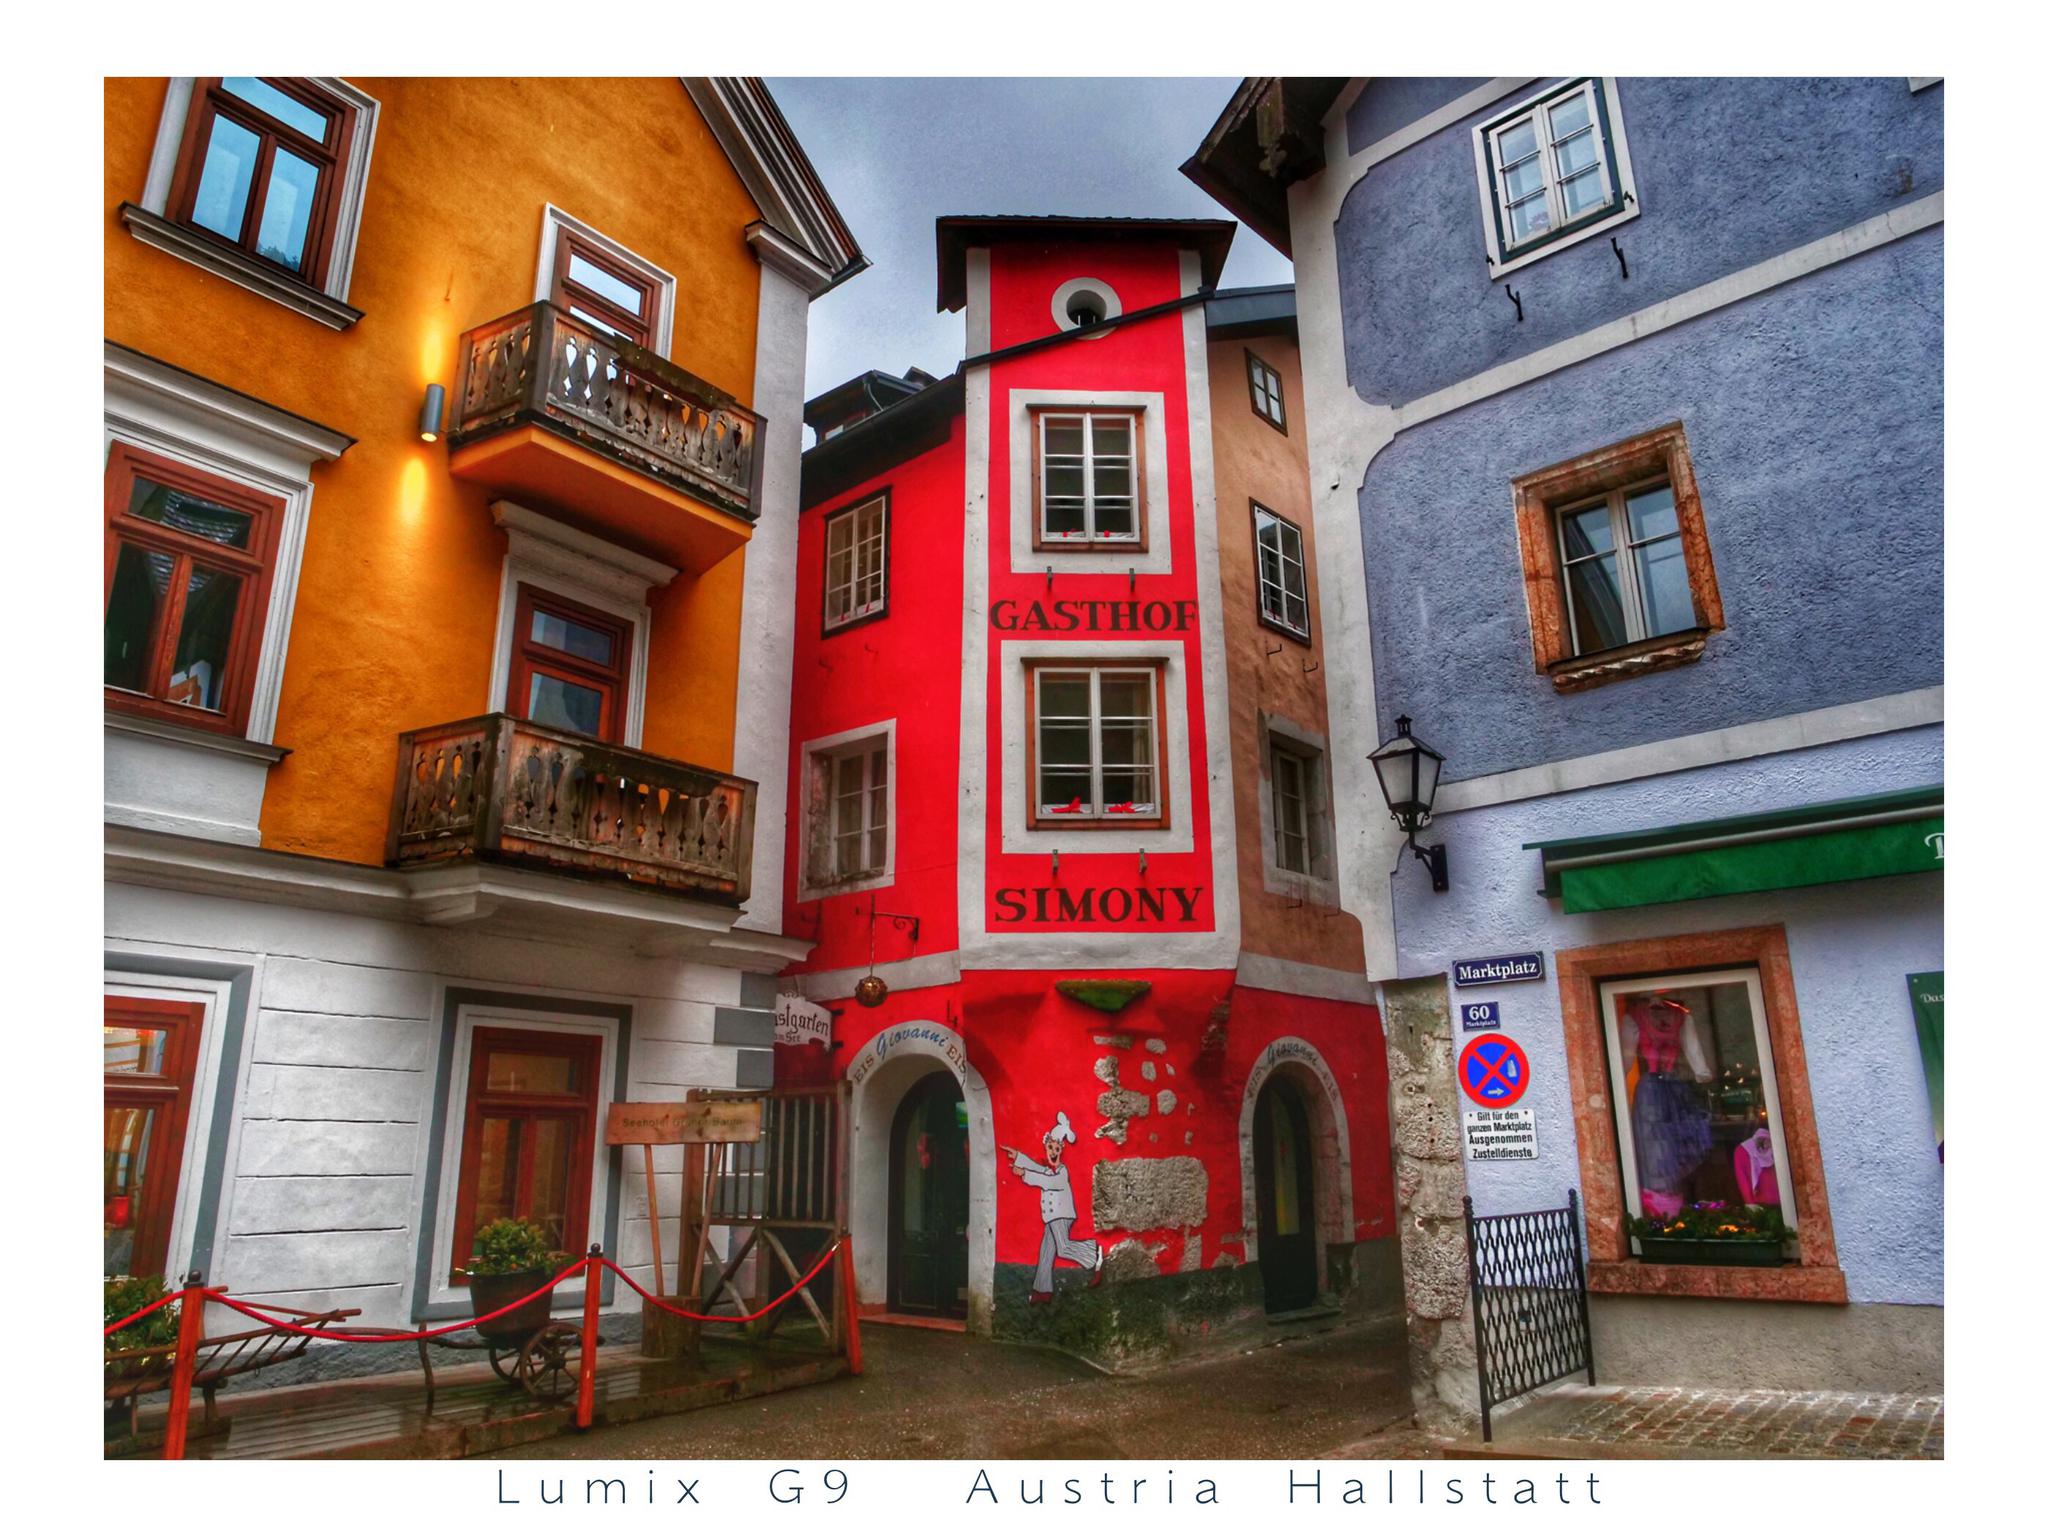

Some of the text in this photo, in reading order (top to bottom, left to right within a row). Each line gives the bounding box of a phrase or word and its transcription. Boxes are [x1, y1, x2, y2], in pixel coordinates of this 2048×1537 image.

[989, 599, 1198, 632] GASTHOF
[994, 887, 1203, 922] SIMONY
[1458, 960, 1537, 980] Marktplatz
[1469, 1005, 1490, 1021] 60
[854, 1027, 967, 1083] EIS Giovanni EIS
[1477, 1110, 1519, 1121] Gilt für den
[1467, 1122, 1532, 1134] ganzen Marktplatz
[1469, 1133, 1533, 1146] Ausgenommen
[1472, 1147, 1533, 1159] Zustelldienste
